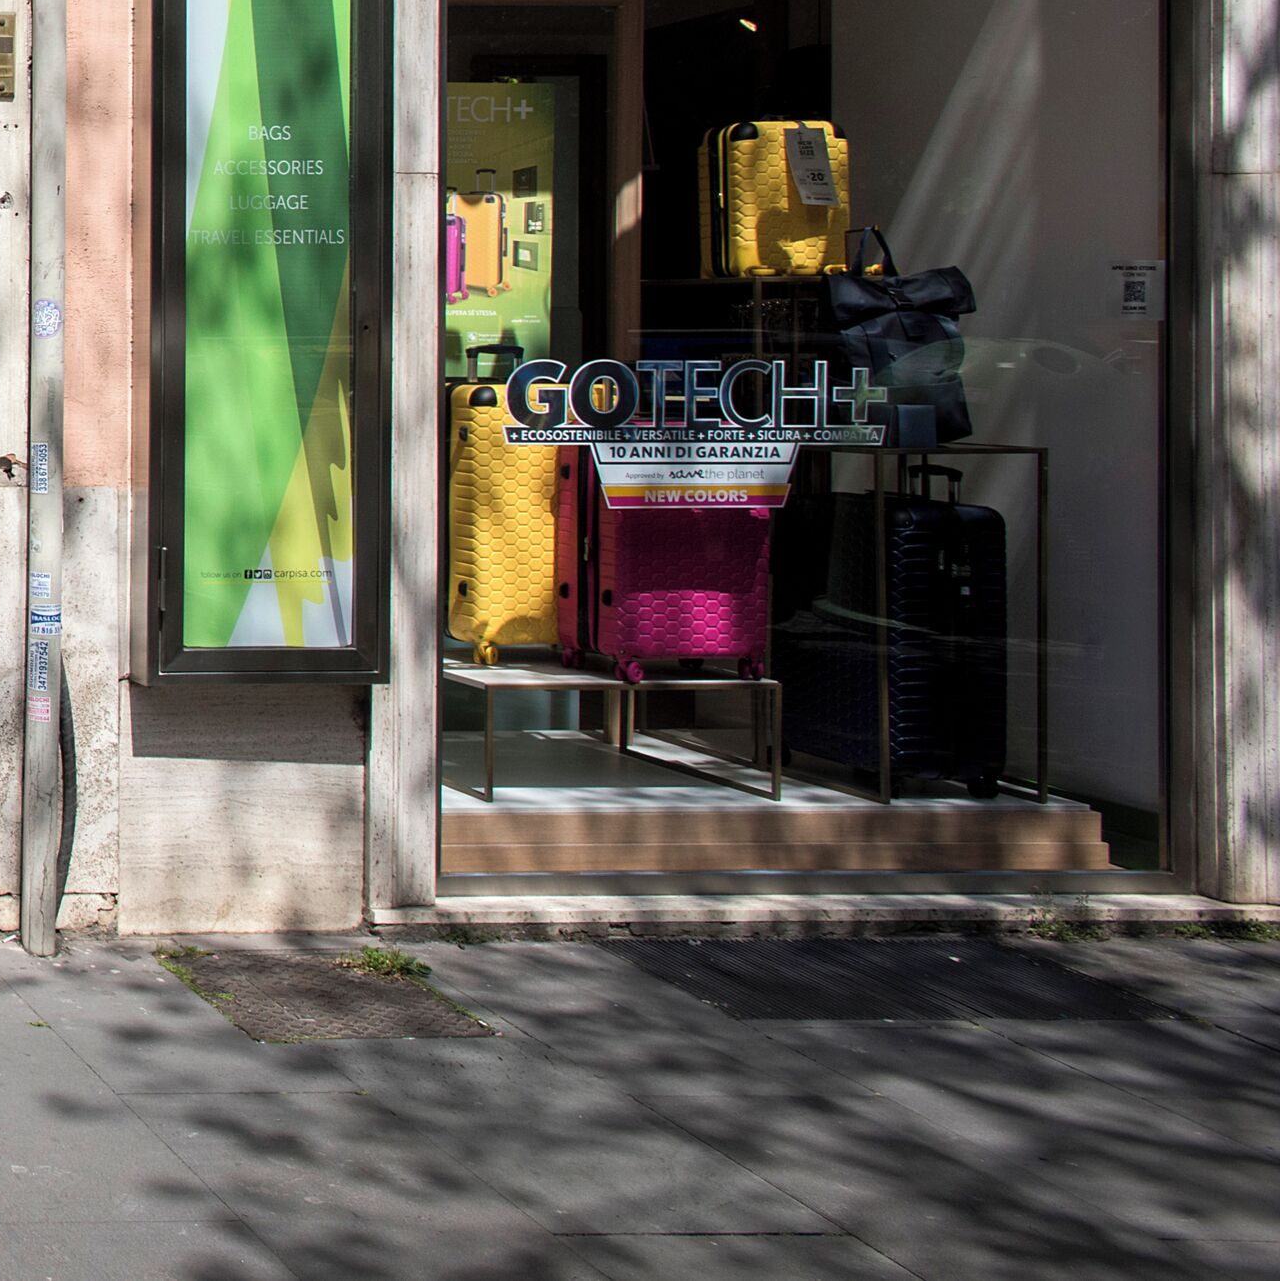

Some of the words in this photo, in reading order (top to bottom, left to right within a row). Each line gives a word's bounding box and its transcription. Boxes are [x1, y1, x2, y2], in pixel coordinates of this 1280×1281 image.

[248, 125, 291, 141] BAGS
[213, 160, 324, 176] ACCESSORIES
[229, 195, 309, 210] LUGGAGE
[191, 230, 249, 245] TRAVEL
[255, 230, 345, 245] ESSENTIALS
[521, 430, 622, 441] ECOSOSTENIBILE
[634, 430, 695, 441] VERSATILE
[707, 430, 745, 441] FORTE
[757, 430, 801, 441] SICURA
[813, 430, 879, 441] COMPATTA
[609, 446, 626, 459] 10
[629, 446, 672, 459] ANNI
[676, 446, 692, 459] DI
[695, 446, 781, 459] GARANZIA
[625, 472, 656, 480] Approved
[657, 472, 664, 480] by
[727, 468, 764, 481] planet
[644, 490, 681, 503] NEW
[684, 490, 748, 503] COLORS
[274, 569, 333, 580] carpisa.com
[37, 641, 48, 691] 3471937542
